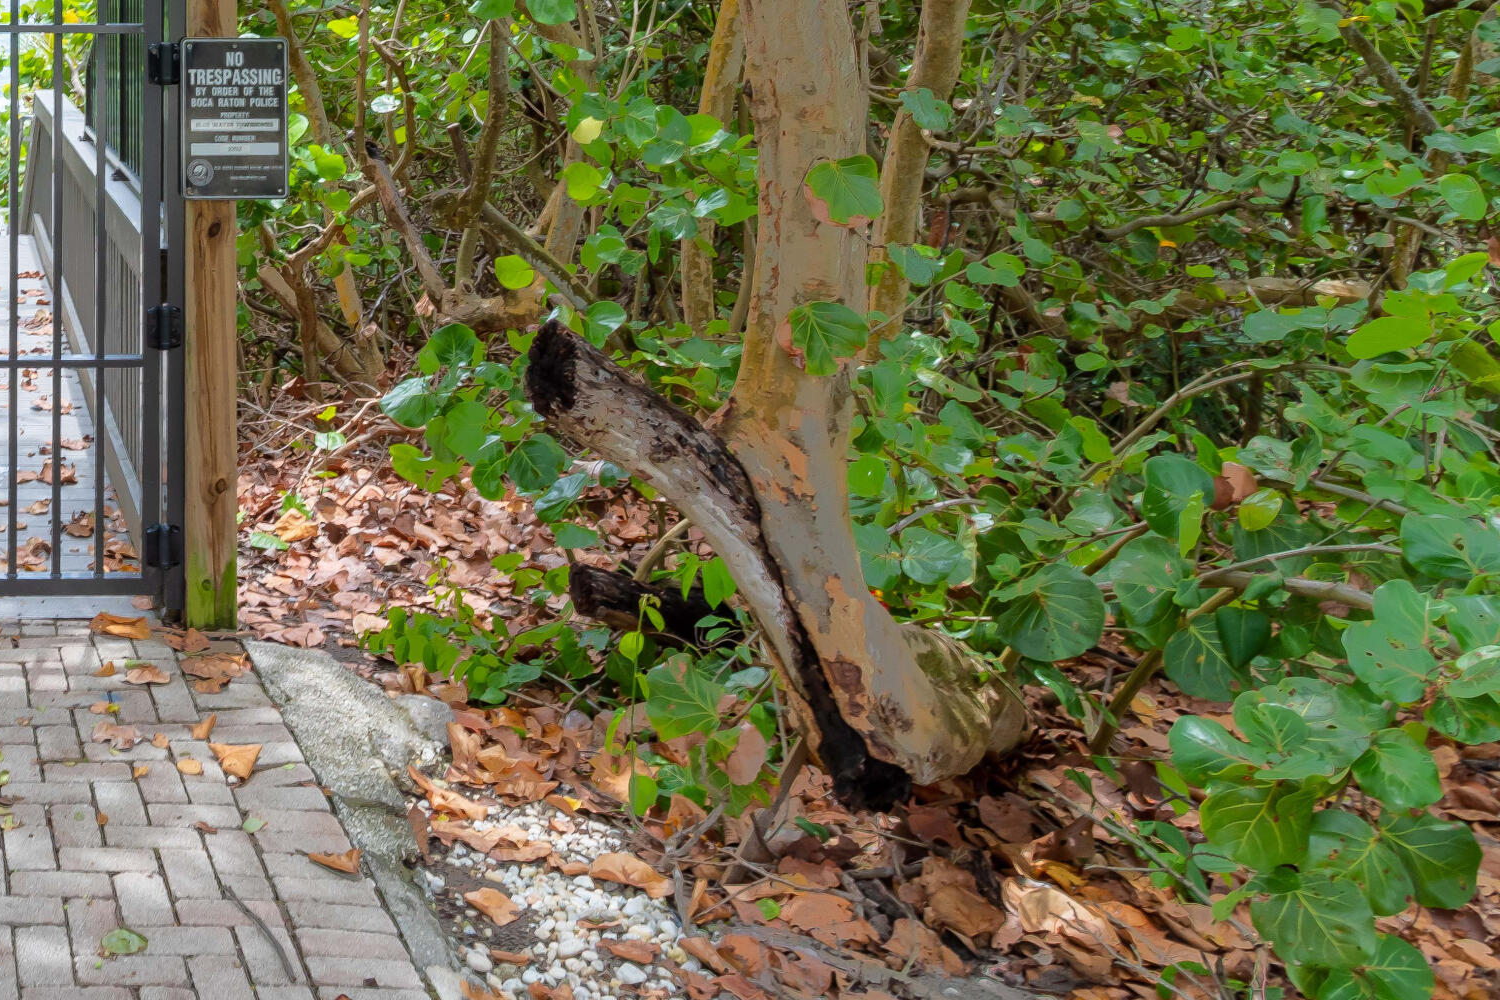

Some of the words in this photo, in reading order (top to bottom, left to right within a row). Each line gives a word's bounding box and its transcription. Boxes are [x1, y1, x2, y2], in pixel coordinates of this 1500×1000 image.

[225, 51, 244, 67] NO
[188, 68, 283, 86] TRESPASSING
[195, 87, 206, 96] BY
[211, 87, 240, 96] ORDER
[243, 87, 255, 96] OF
[259, 87, 275, 96] THE
[191, 97, 213, 108] BOCA
[218, 97, 245, 108] RATON
[250, 97, 280, 108] POLICE
